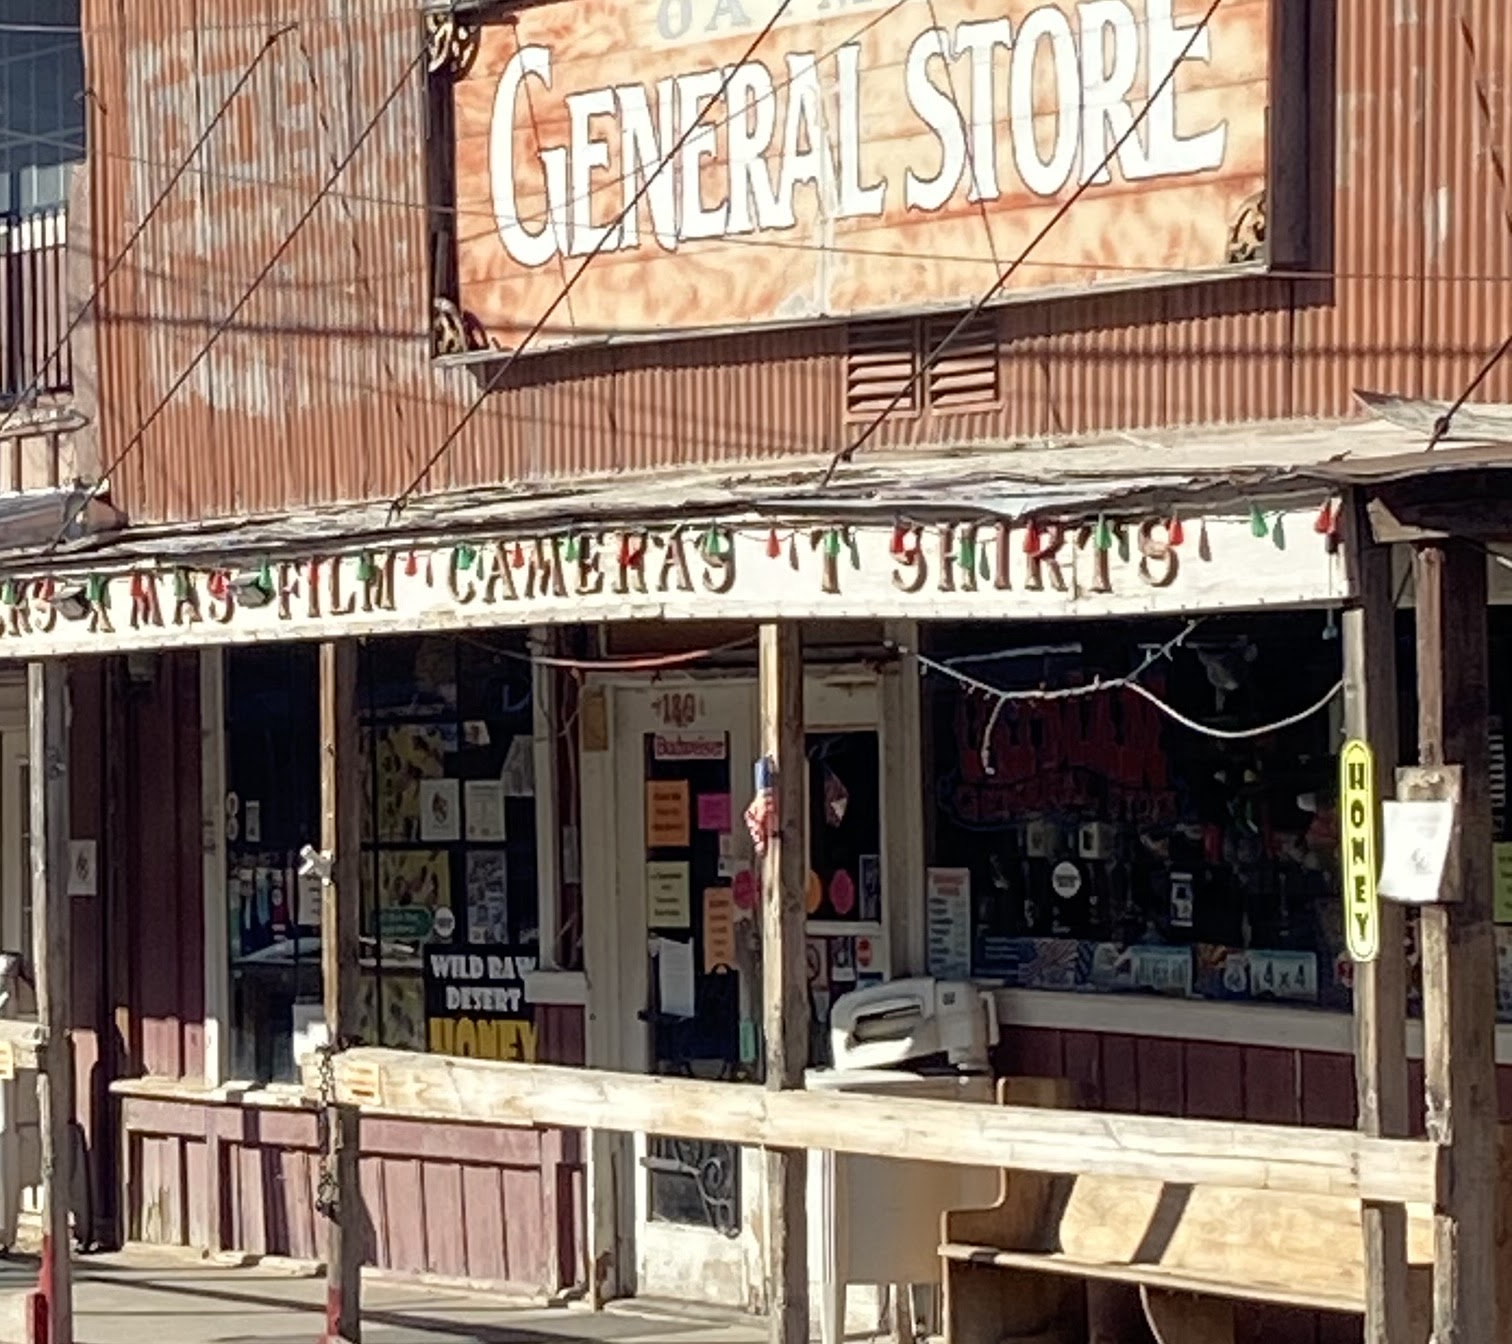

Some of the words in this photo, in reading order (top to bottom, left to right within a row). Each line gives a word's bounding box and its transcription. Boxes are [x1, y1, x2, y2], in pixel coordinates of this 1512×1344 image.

[489, 43, 887, 268] GENERAL
[278, 552, 397, 620] FILM
[448, 528, 737, 604] CAMERAS
[891, 518, 1181, 594] SHIRTS
[1347, 761, 1371, 942] HONEY
[430, 954, 484, 979] WILD
[445, 985, 522, 1012] DESERT
